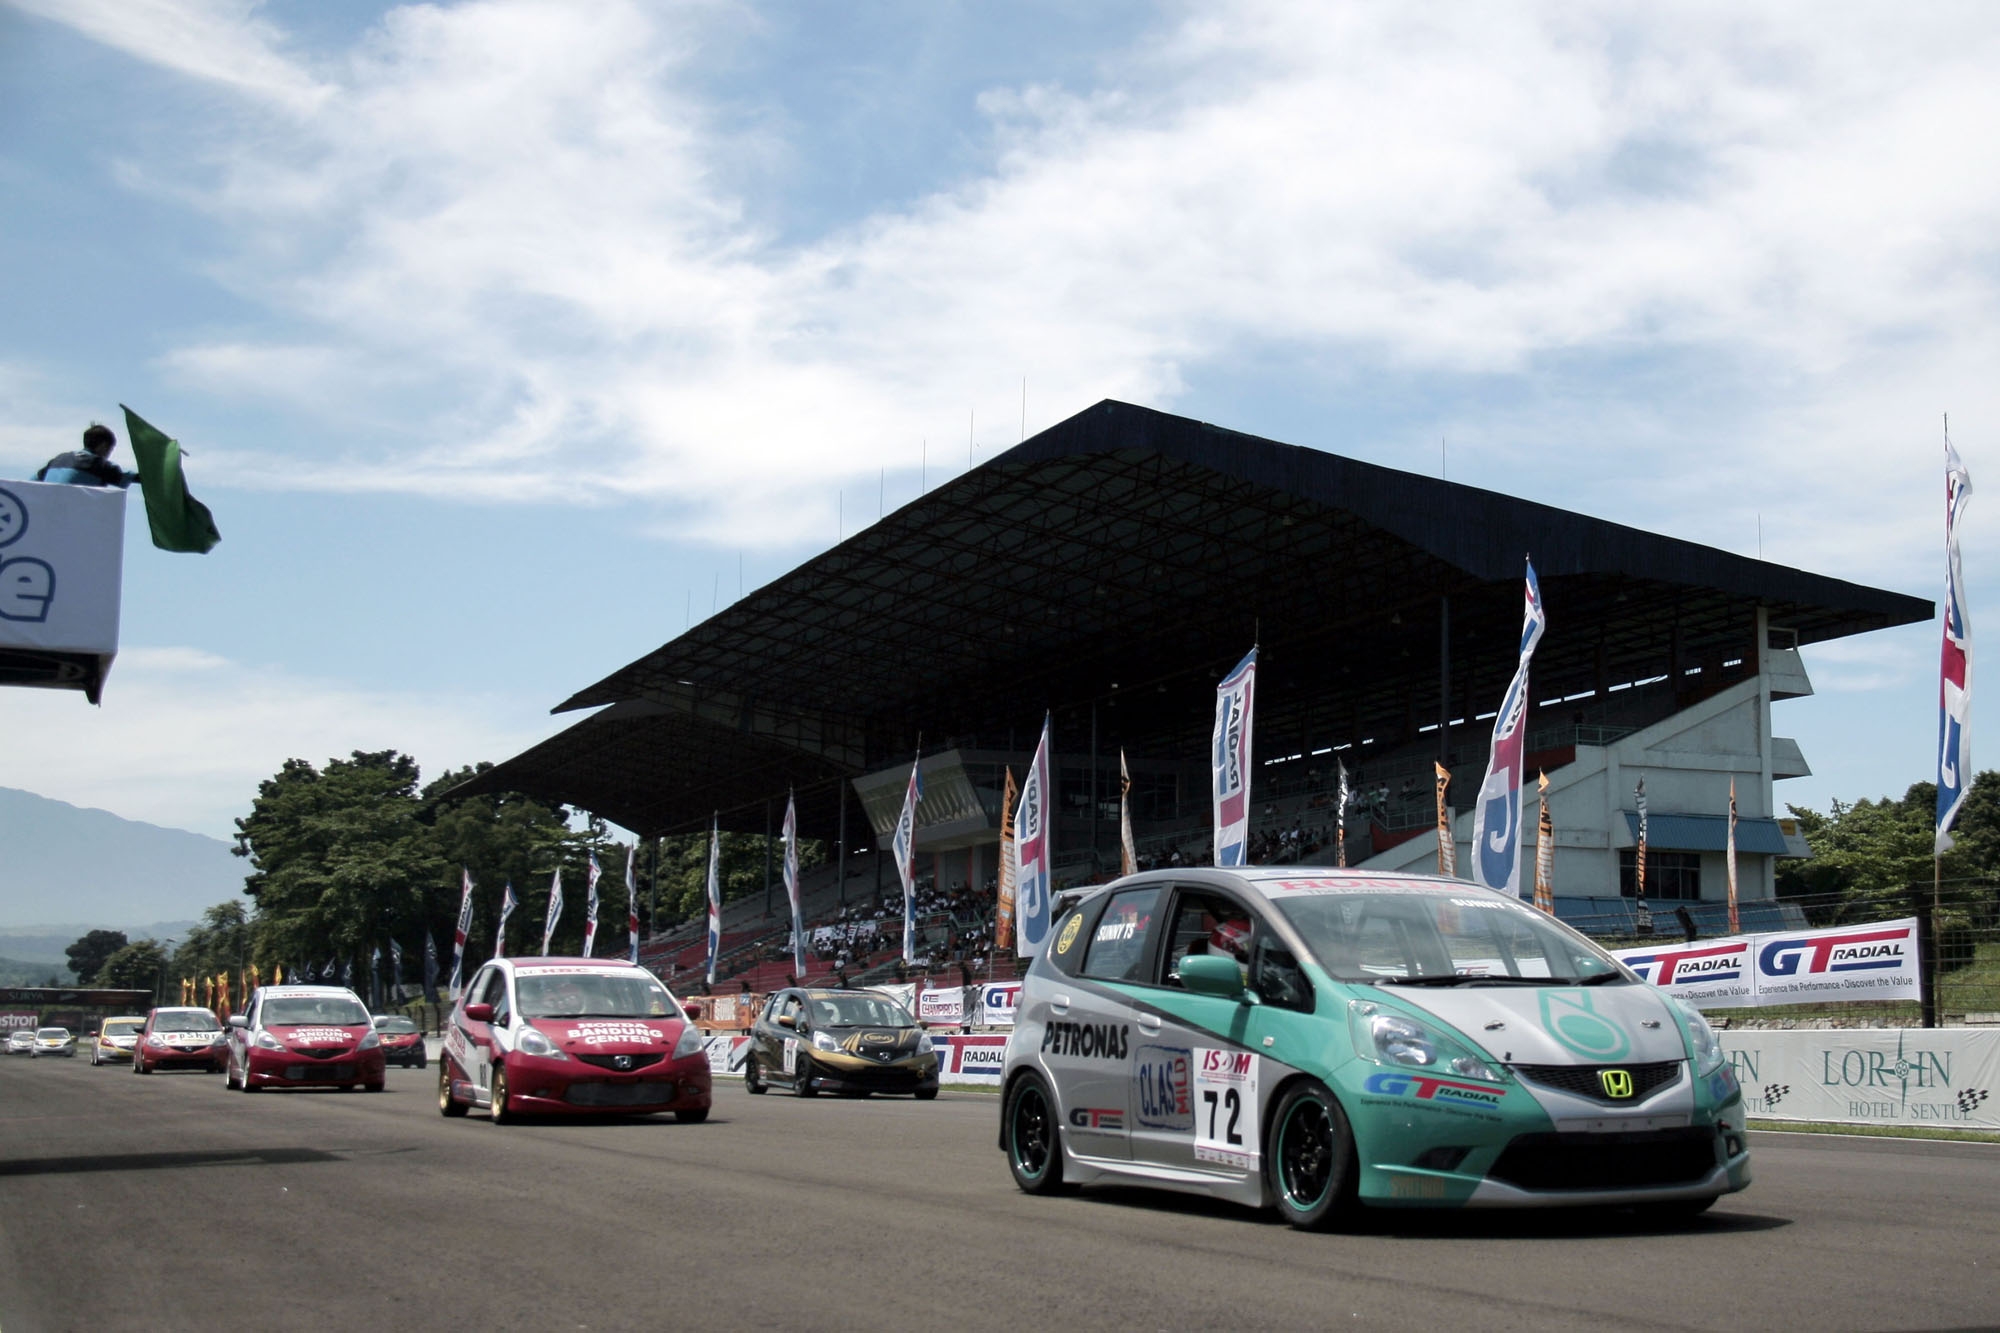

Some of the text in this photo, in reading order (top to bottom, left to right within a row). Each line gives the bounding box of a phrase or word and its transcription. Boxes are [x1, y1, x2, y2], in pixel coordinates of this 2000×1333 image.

[1097, 924, 1126, 941] SUNNY
[1833, 944, 1904, 960] RADIAL
[1678, 958, 1742, 973] RADIAL
[1717, 988, 1728, 997] the
[1729, 986, 1750, 996] Value
[1759, 985, 1788, 994] Experience
[1788, 984, 1798, 992] the
[1800, 980, 1840, 991] Performance
[1877, 977, 1889, 986] the
[1891, 976, 1913, 985] Value
[985, 987, 1021, 1008] GT
[0, 1014, 38, 1027] stron
[567, 1029, 664, 1038] BANDUNG
[585, 1035, 652, 1045] CENTER
[1041, 1022, 1129, 1060] PETRONAS
[963, 1051, 1003, 1062] RADIAL
[1141, 1061, 1176, 1116] CLAS
[1175, 1058, 1190, 1114] MILD
[1438, 1088, 1500, 1104] RADIAL
[1204, 1088, 1243, 1146] 72
[1849, 1101, 1898, 1118] HOTEL
